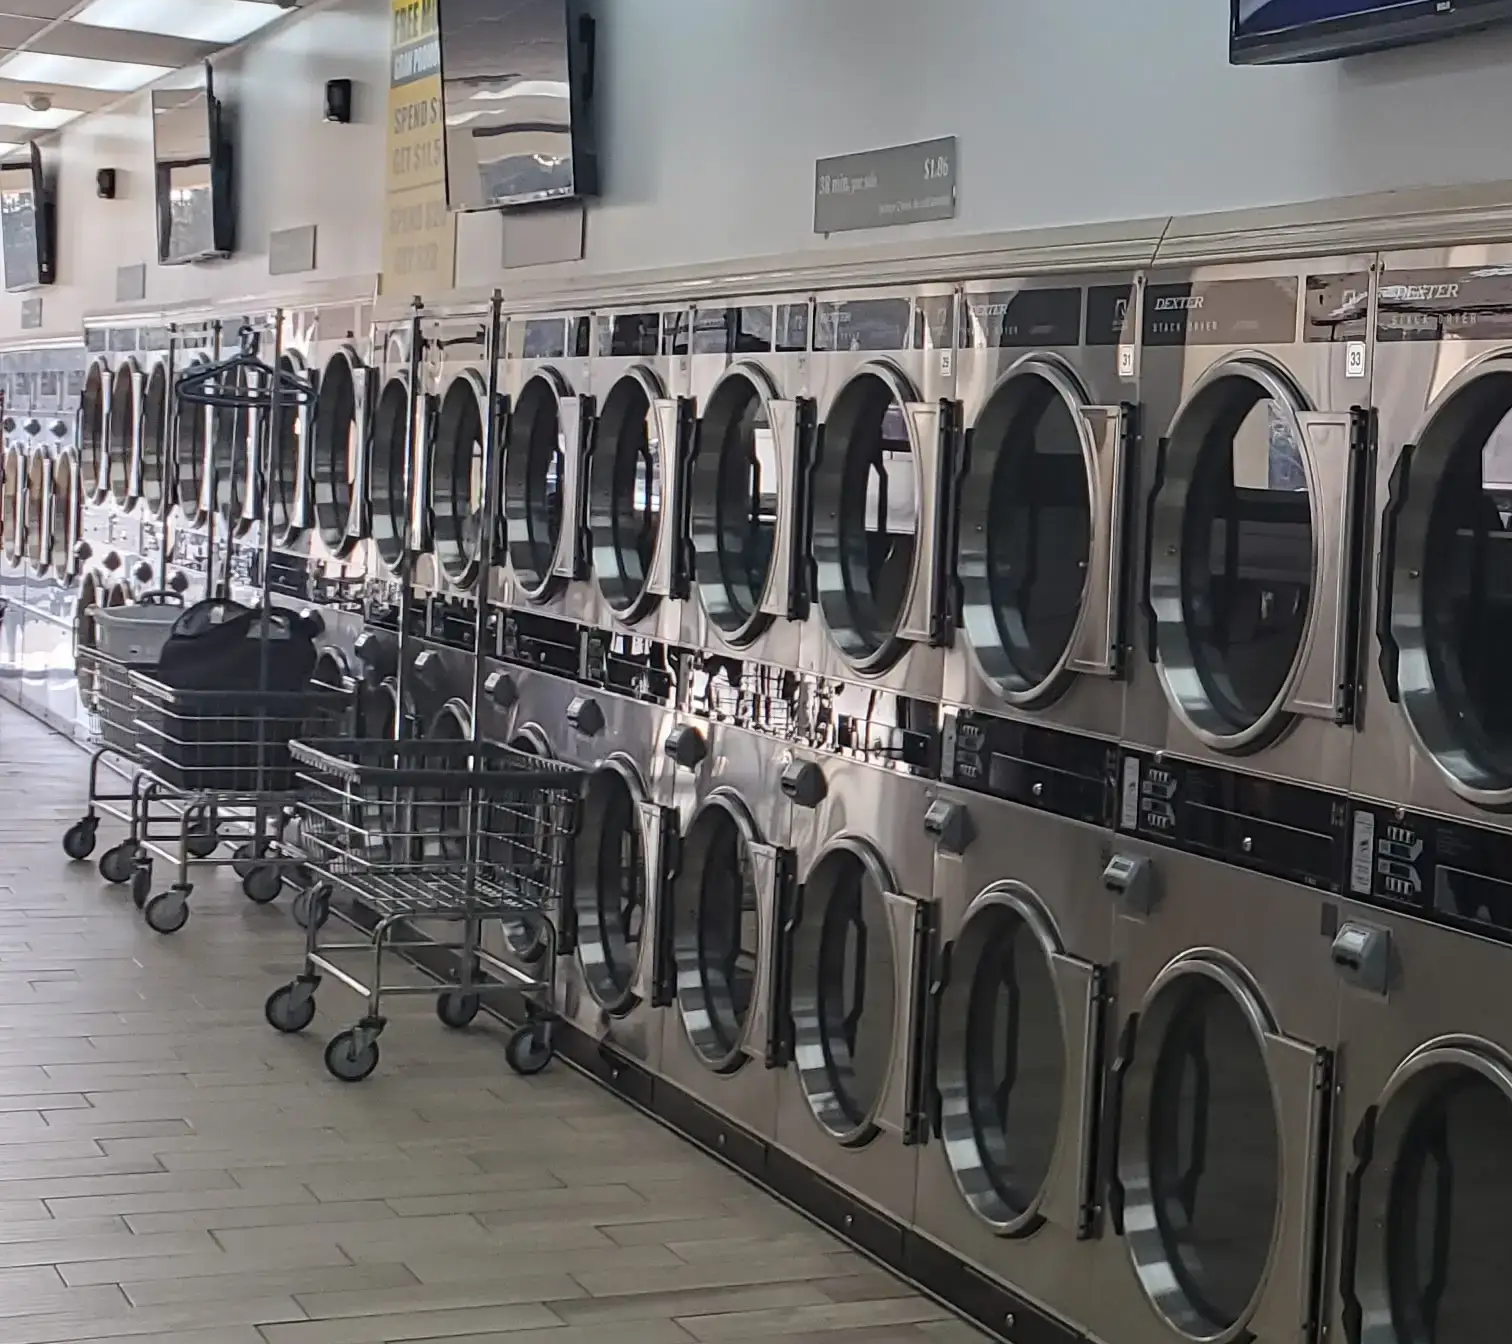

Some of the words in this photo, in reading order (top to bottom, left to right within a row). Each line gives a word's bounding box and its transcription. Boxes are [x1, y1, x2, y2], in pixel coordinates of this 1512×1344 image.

[1395, 283, 1459, 301] DEXTER
[1154, 296, 1204, 310] DEXTER
[1122, 354, 1131, 366] 31
[1350, 351, 1361, 366] 33
